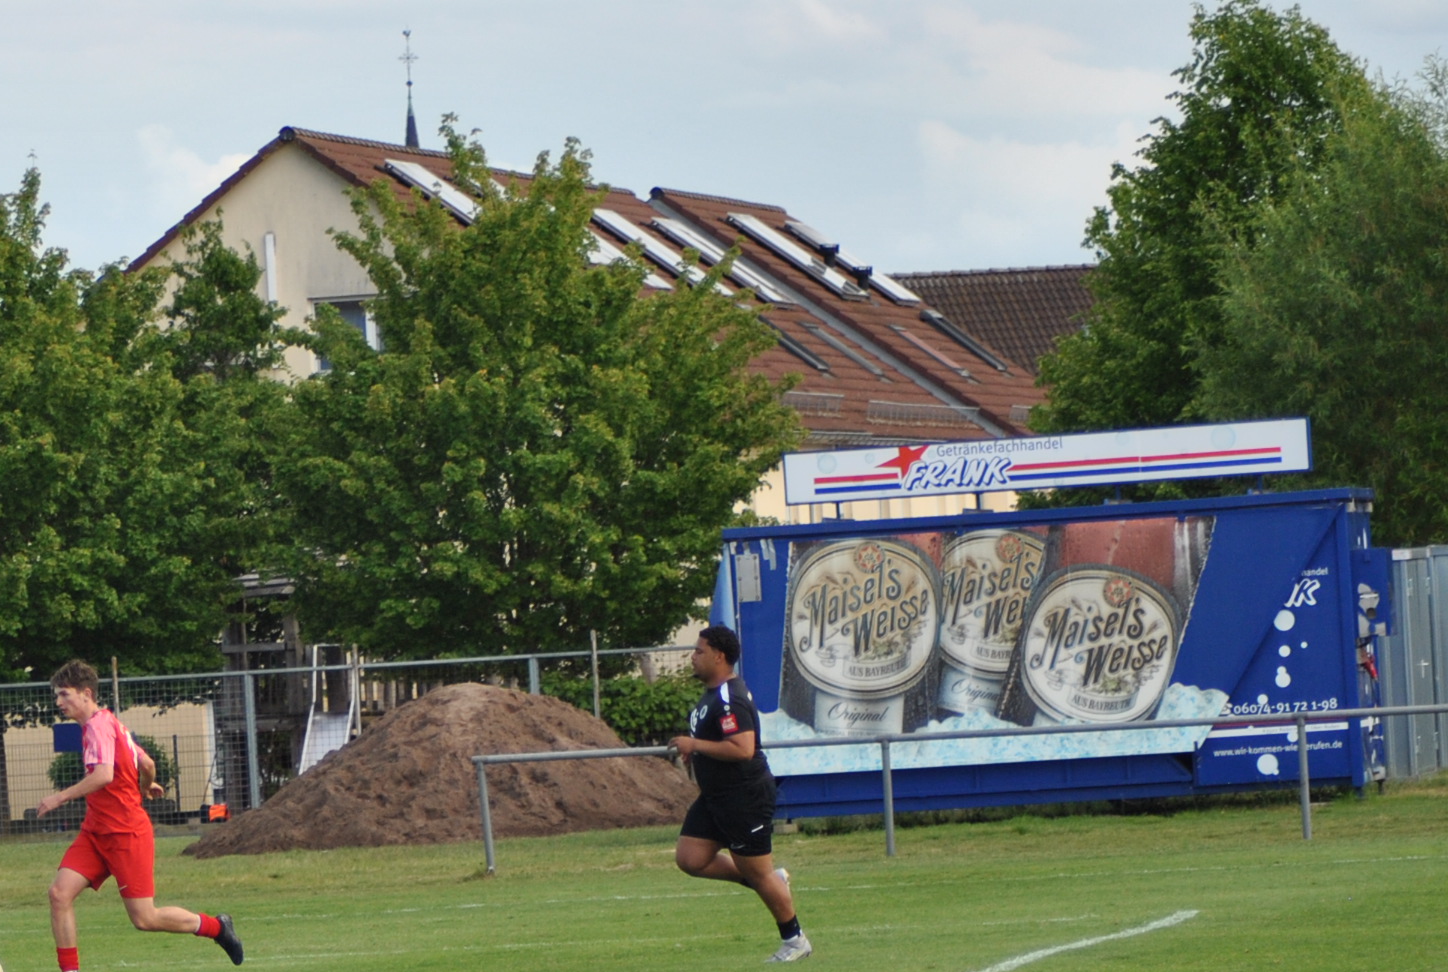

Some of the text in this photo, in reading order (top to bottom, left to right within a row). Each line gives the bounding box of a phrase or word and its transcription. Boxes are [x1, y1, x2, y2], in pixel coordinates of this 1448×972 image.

[904, 456, 1012, 491] FRANK
[936, 437, 1063, 458] Getränkefachhandel
[799, 558, 902, 653] Maisel's
[941, 551, 1036, 626] Maisel's
[840, 588, 930, 657] Weisse
[1029, 596, 1147, 671] Maisel's
[1073, 634, 1169, 687] Weisse
[827, 701, 890, 728] Original
